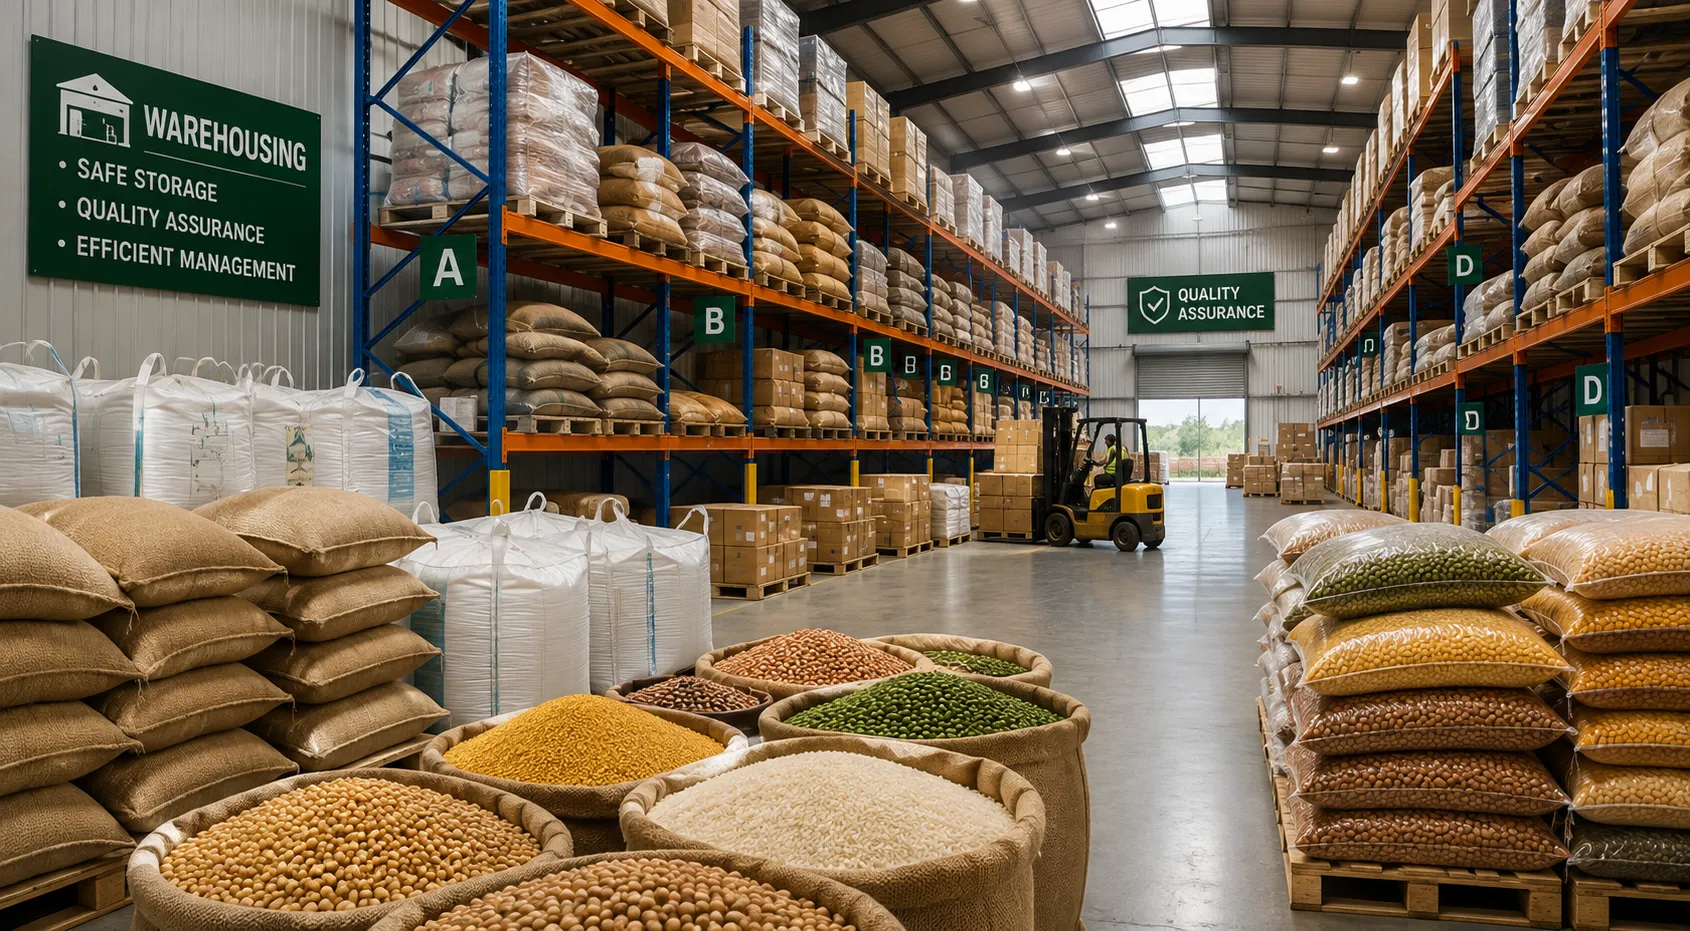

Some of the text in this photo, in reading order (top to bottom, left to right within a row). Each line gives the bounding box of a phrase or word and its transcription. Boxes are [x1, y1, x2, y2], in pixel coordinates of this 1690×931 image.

[143, 104, 306, 172] WAREHOUSING
[77, 157, 218, 203] SAFE STORAGE
[77, 196, 265, 243] QUALITY ASSURANCE
[77, 235, 296, 282] EFFICIENT MANAGEMENT
[432, 248, 464, 287] A
[1456, 254, 1474, 277] D
[1178, 286, 1240, 303] QUALITY
[705, 307, 725, 335] B
[1177, 304, 1265, 321] ASSURANCE
[870, 345, 884, 366] B
[940, 364, 952, 381] B
[1584, 375, 1602, 405] D
